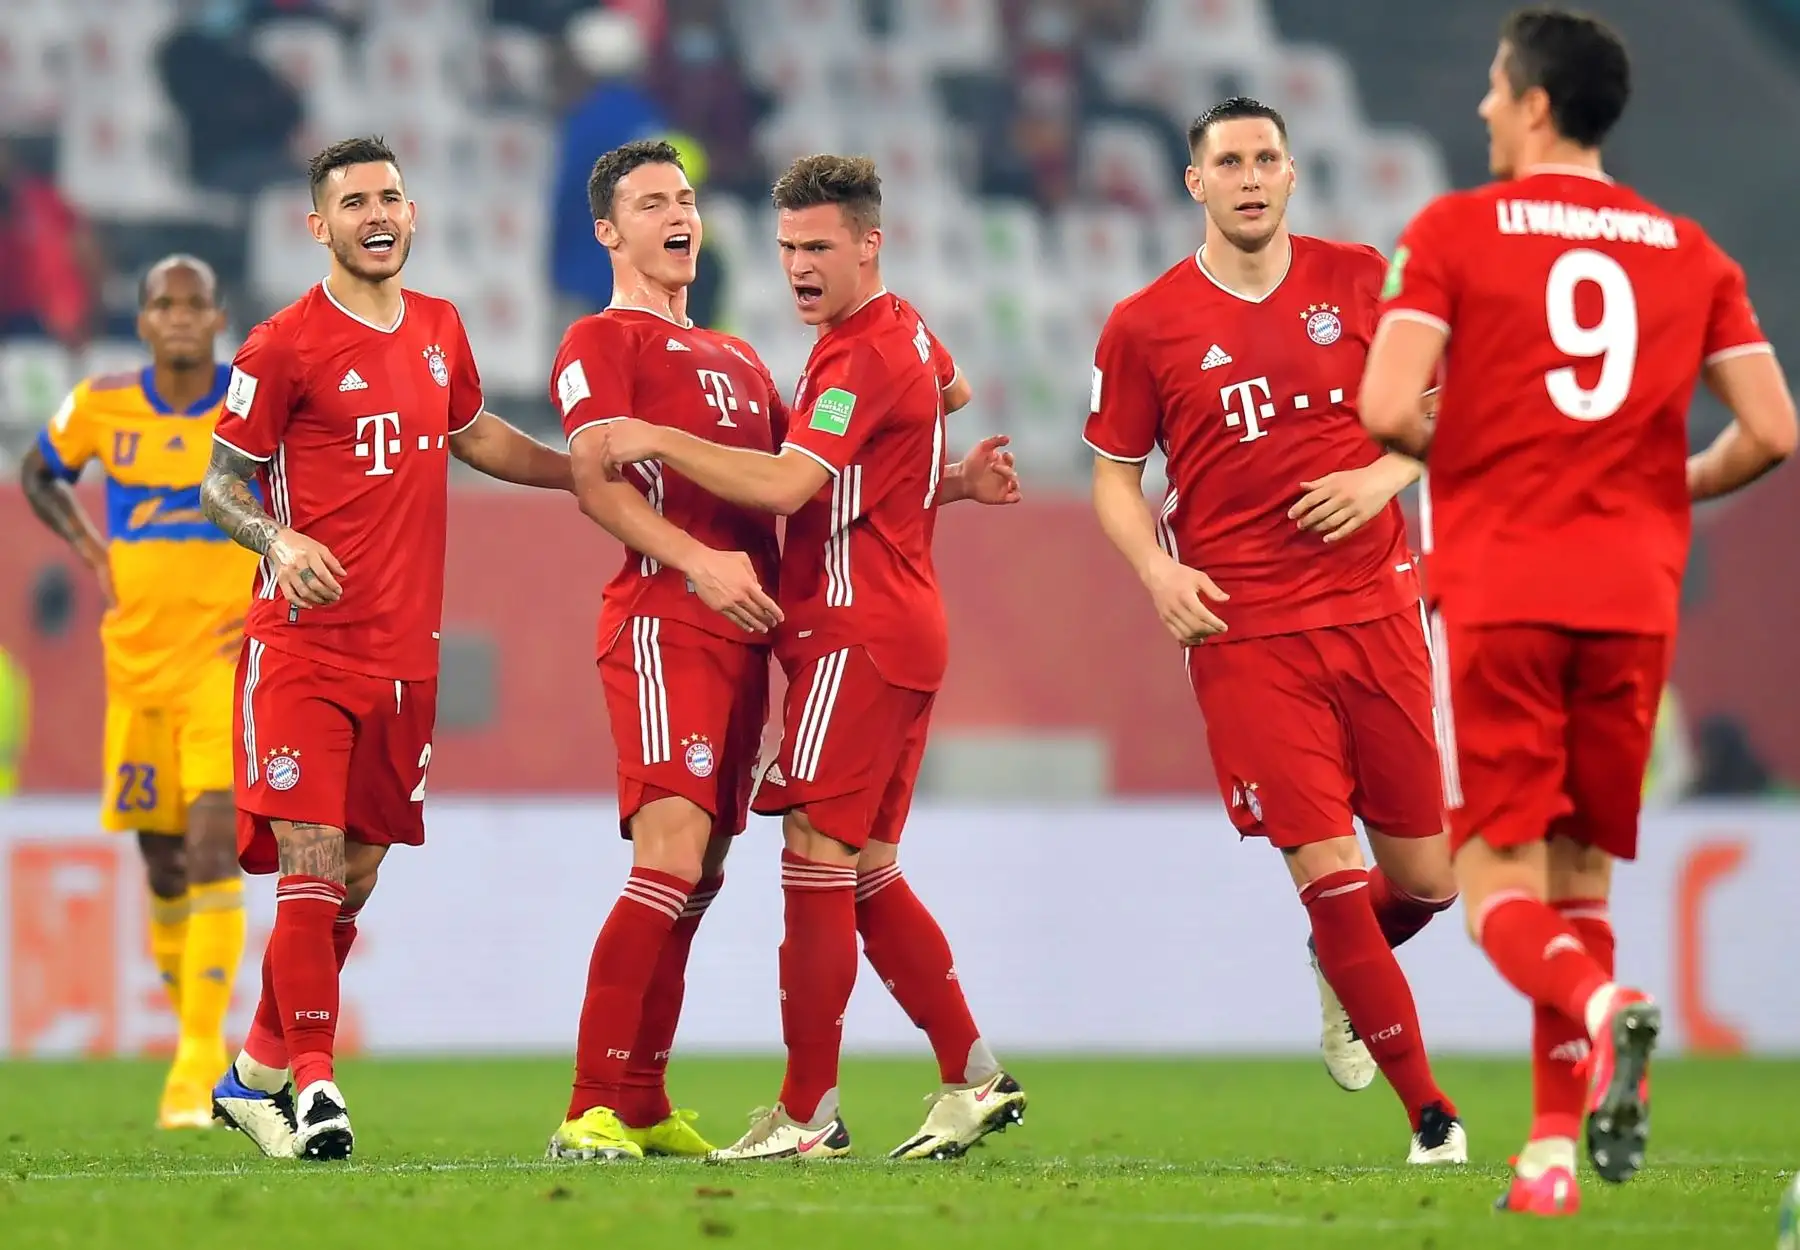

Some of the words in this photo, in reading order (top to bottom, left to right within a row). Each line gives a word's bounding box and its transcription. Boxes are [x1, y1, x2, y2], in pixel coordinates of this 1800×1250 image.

[1496, 198, 1679, 249] LEWANDOWSKI
[1544, 247, 1639, 422] 9
[1200, 355, 1233, 371] adidas
[338, 381, 369, 392] adidas
[117, 763, 157, 812] 23
[295, 1010, 330, 1021] FCB
[1370, 1023, 1403, 1044] FCB
